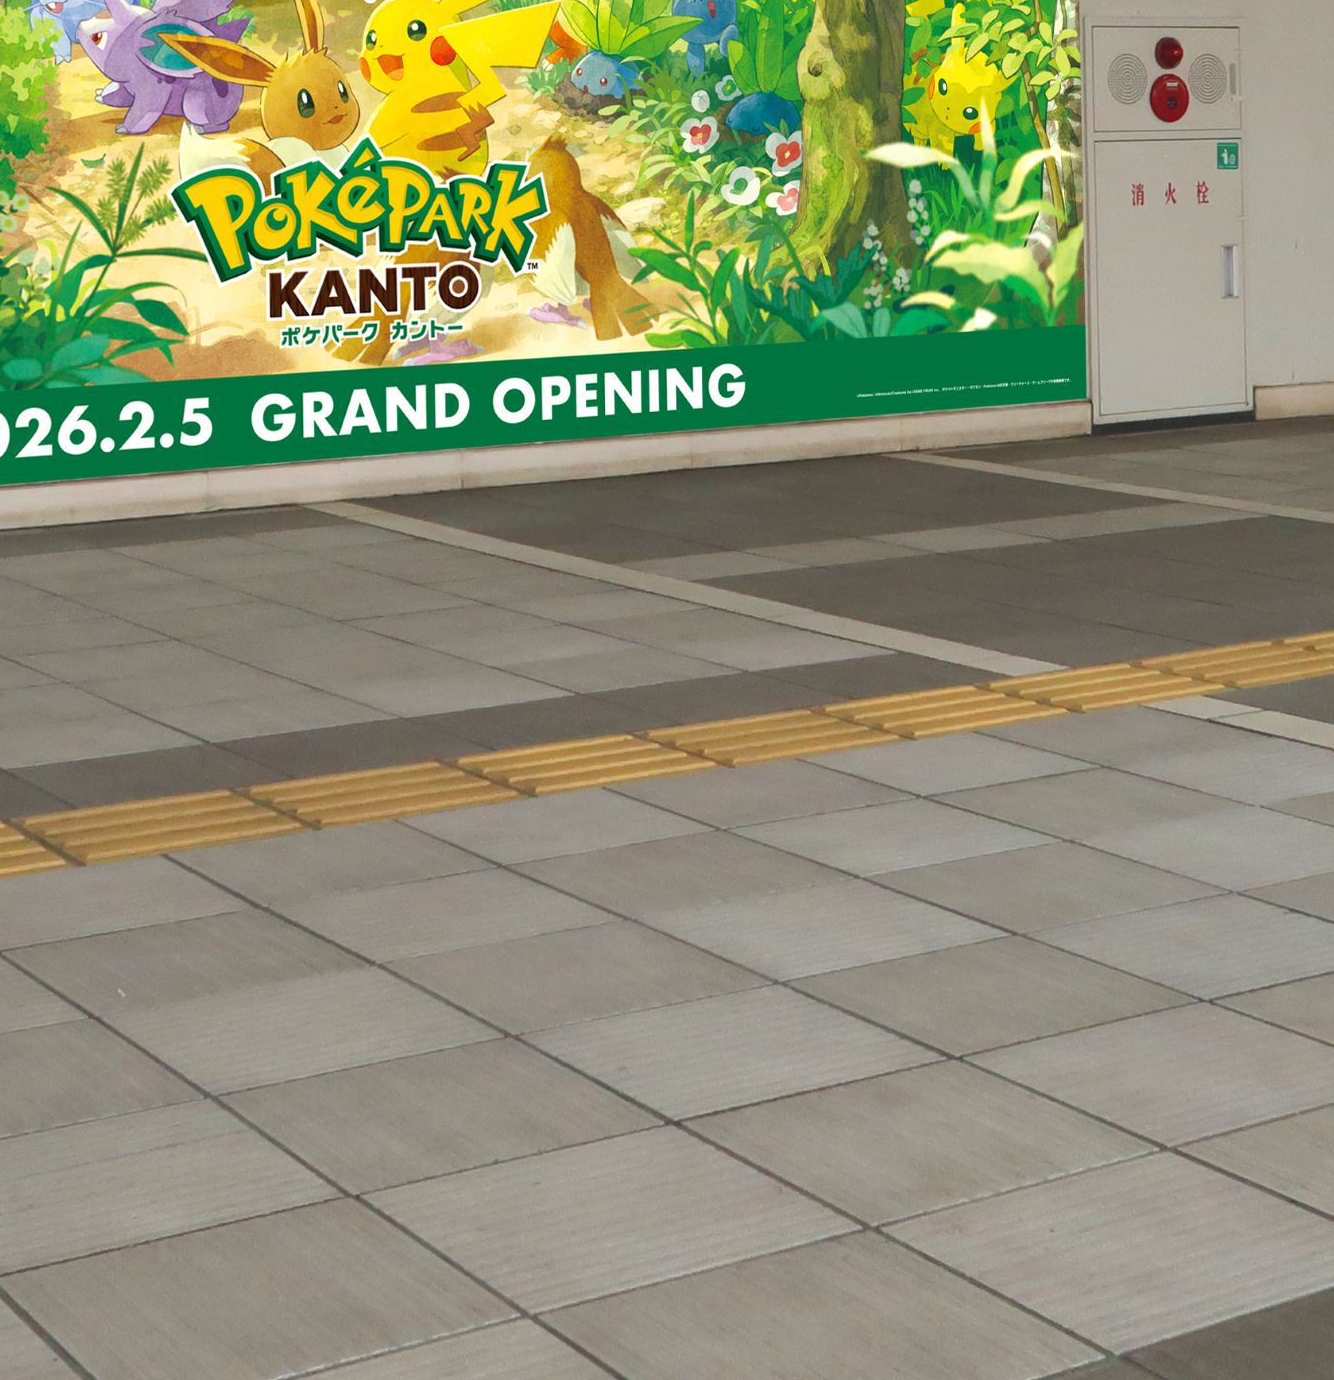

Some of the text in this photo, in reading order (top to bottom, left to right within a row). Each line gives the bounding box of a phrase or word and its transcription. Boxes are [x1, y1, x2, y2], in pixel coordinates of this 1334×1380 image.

[1131, 180, 1210, 207] 消火栓
[269, 265, 479, 318] KANTO
[281, 321, 463, 347] ポケパーク カントー
[250, 381, 469, 442] GRAND
[492, 363, 748, 424] OPENING
